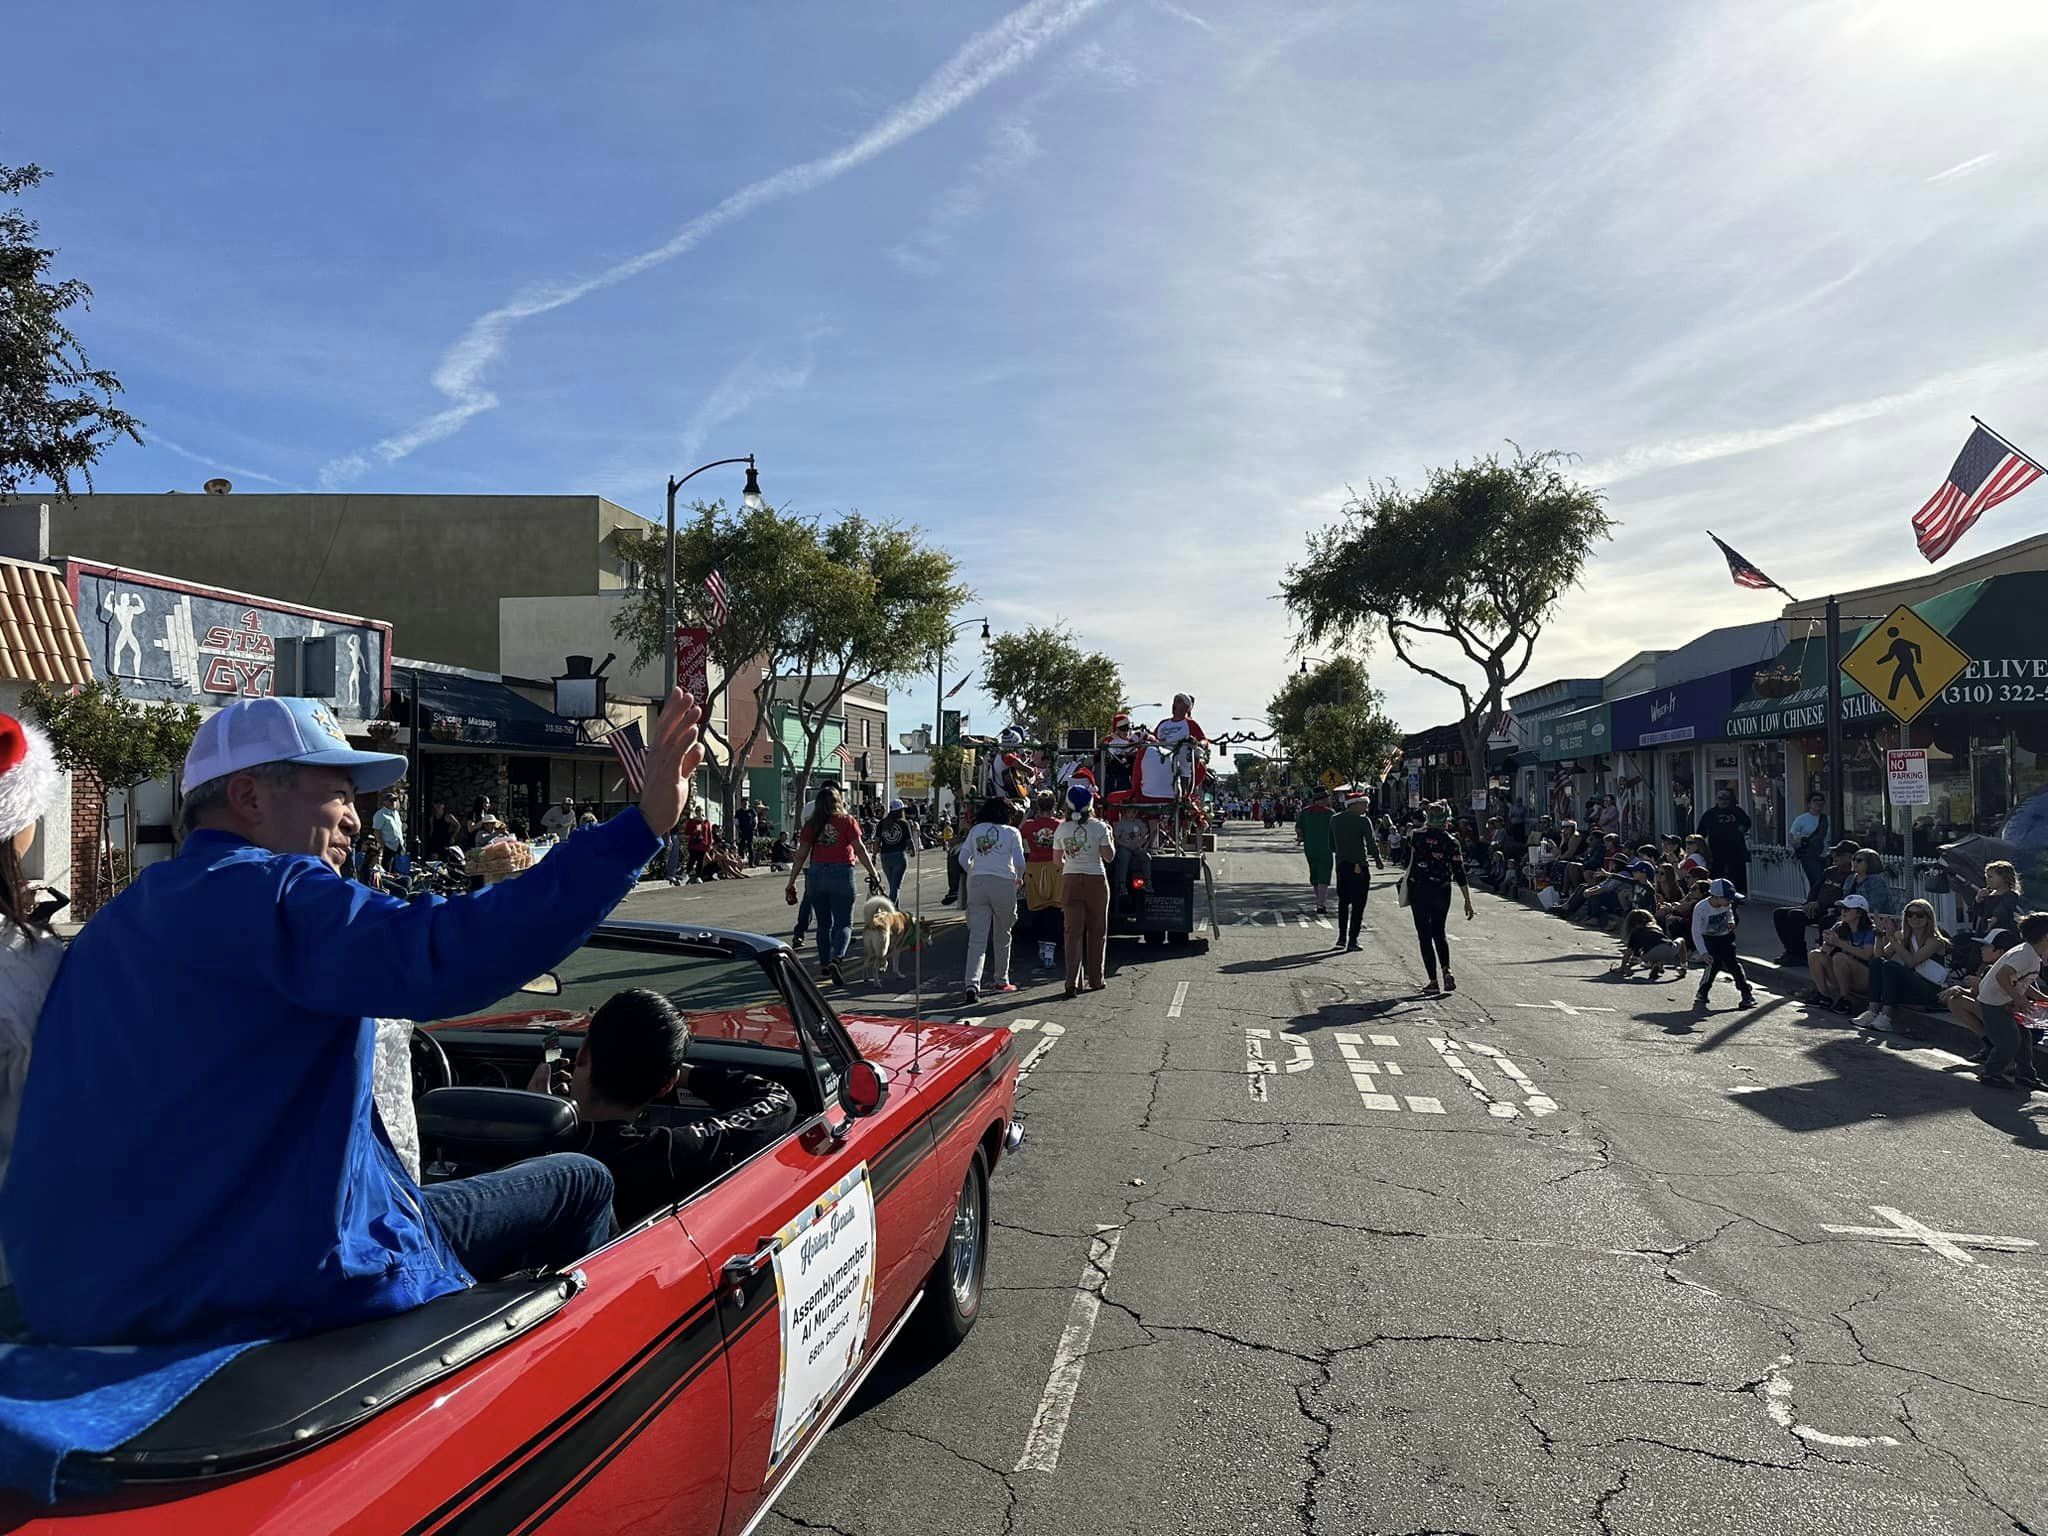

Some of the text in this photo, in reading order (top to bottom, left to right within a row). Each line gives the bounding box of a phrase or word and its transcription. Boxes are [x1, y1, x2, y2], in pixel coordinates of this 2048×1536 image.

[241, 608, 262, 633] 4
[202, 625, 275, 656] STA
[1965, 658, 2048, 679] ELIVE
[1941, 682, 1993, 705] (310)
[468, 716, 497, 729] Massage
[1726, 716, 1758, 736] CANTON
[1761, 711, 1781, 732] LOW
[1783, 704, 1825, 729] CHINESE
[1890, 751, 1923, 759] TEMPORARY
[1890, 759, 1905, 771] NO
[1892, 771, 1923, 780] PARKING
[1245, 1028, 1558, 1119] PED
[800, 1204, 855, 1276] Holiday Parade
[792, 1241, 868, 1330] Assemblymember
[802, 1268, 860, 1345] Al Muratsuchi
[808, 1311, 850, 1366] 66th District
